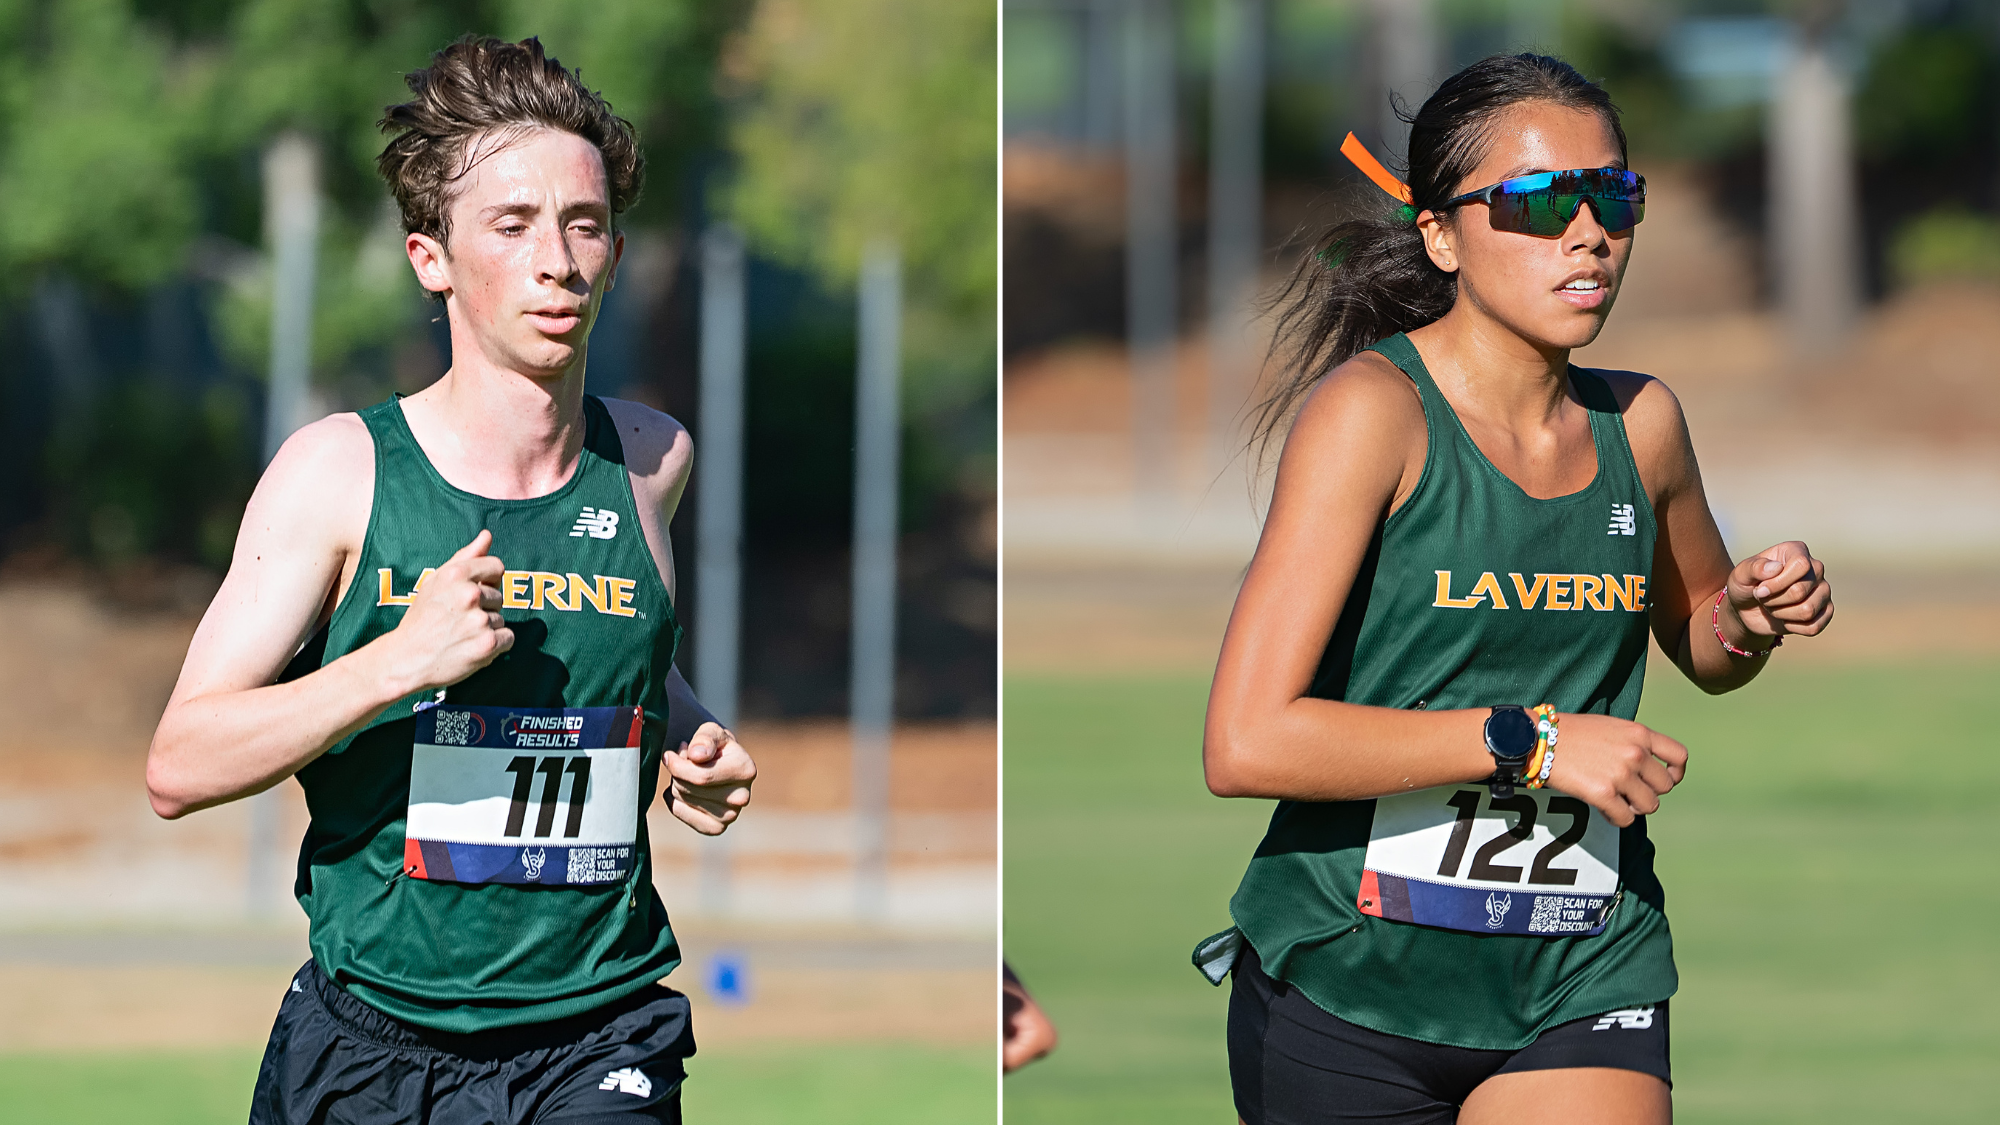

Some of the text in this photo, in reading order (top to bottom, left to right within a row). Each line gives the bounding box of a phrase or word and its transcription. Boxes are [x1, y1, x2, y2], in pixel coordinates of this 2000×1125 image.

[501, 570, 637, 618] ERNE
[1432, 569, 1646, 612] LA VERNE
[520, 716, 584, 730] FINISHED
[516, 733, 579, 747] RESULTS
[504, 756, 592, 838] 111
[1437, 790, 1590, 885] 122
[597, 848, 629, 859] SCAN FOR
[597, 860, 615, 870] YOUR
[596, 869, 626, 881] DISCOUNT
[1564, 899, 1604, 909] SCAN FOR
[1563, 910, 1584, 920] YOUR
[1559, 921, 1594, 932] DISCOUNT
